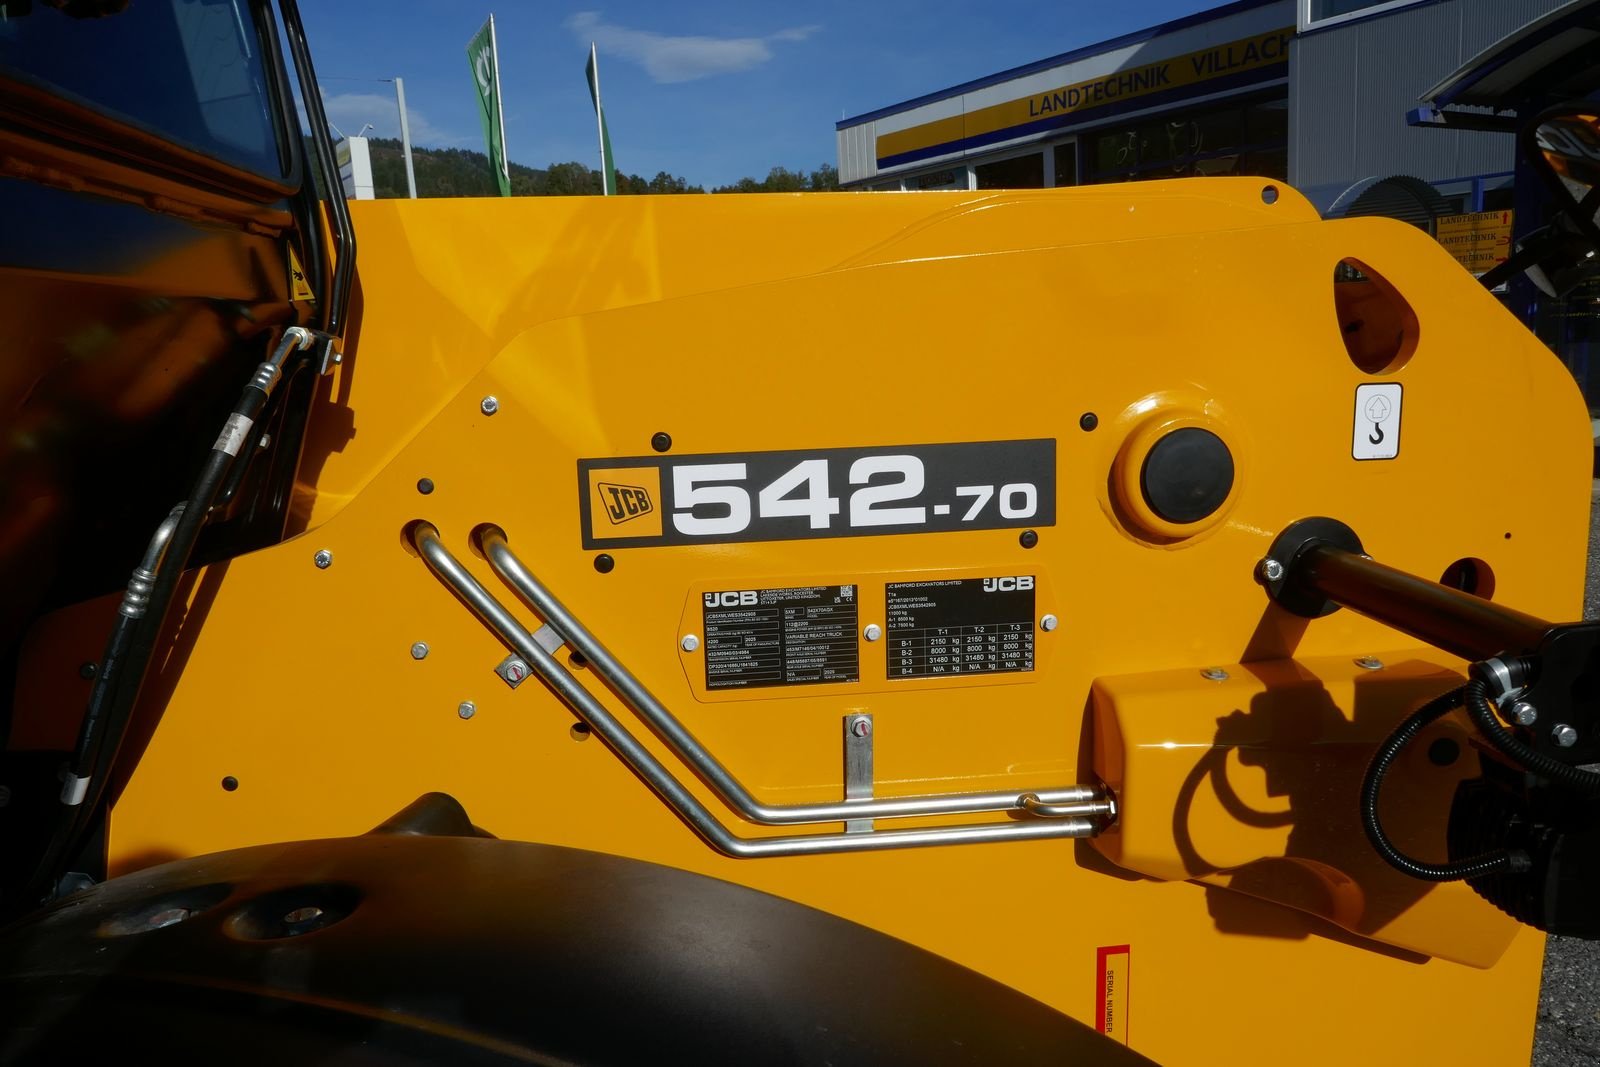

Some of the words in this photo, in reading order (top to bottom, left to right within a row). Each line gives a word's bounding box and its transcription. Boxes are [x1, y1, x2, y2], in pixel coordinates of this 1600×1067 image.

[1029, 64, 1170, 116] LANDTECHNIK
[1440, 212, 1499, 224] LANDTECHNIK
[607, 486, 650, 521] JCB
[984, 576, 1034, 592] JCB
[705, 591, 758, 607] JCB
